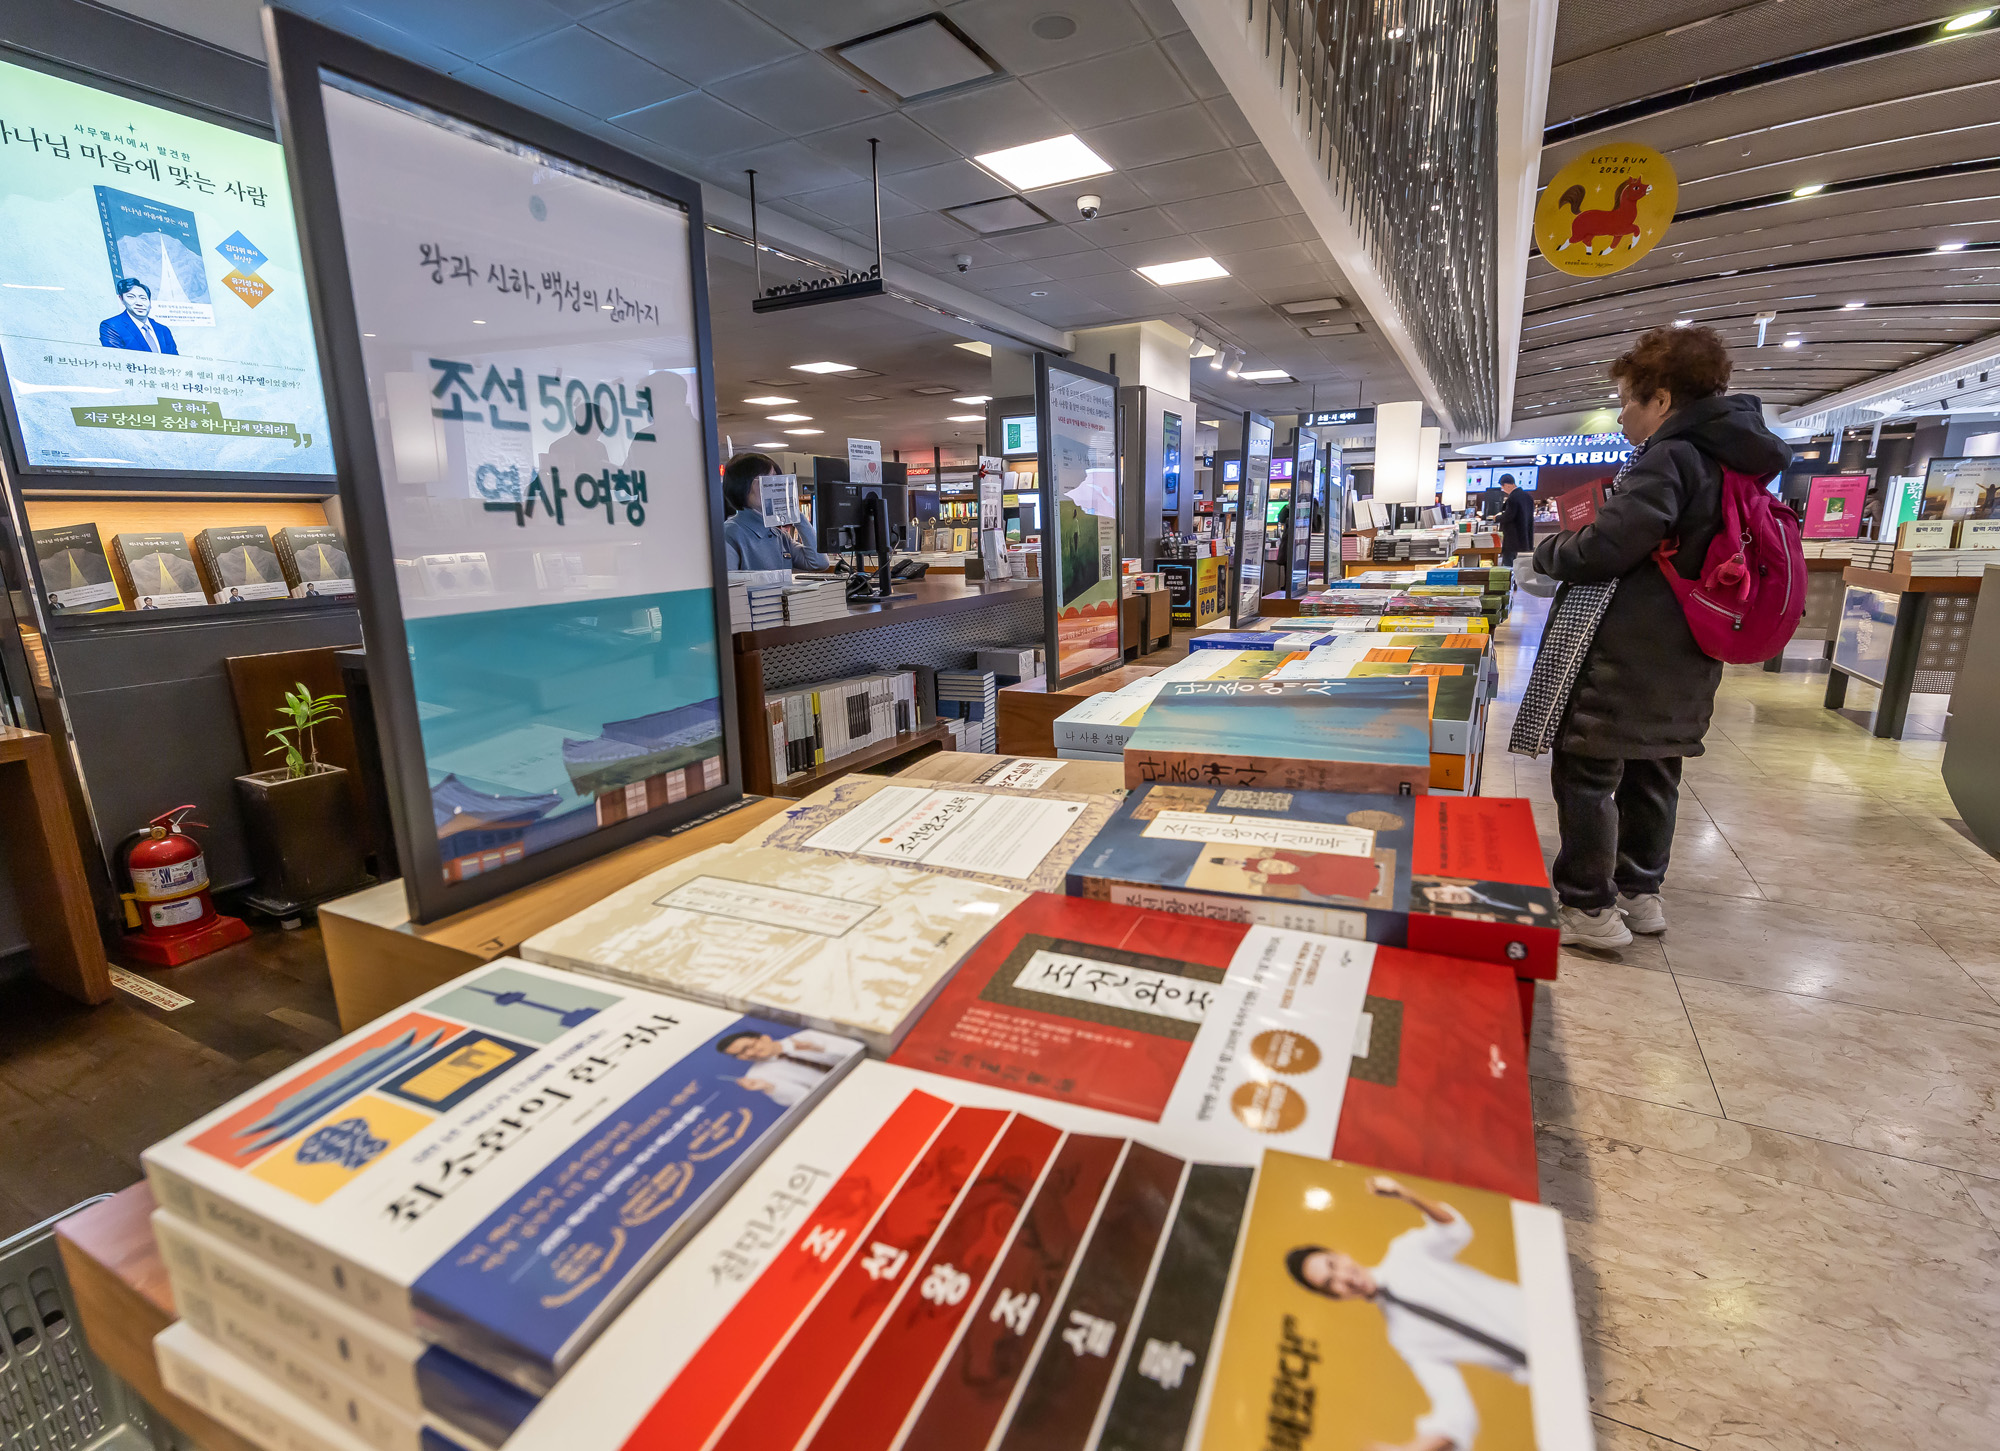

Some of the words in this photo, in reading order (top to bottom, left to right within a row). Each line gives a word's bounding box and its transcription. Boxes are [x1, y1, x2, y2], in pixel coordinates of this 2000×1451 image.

[74, 123, 149, 152] 사무엘서에서
[156, 145, 190, 163] 발견한
[79, 144, 161, 182] 마음에
[167, 163, 216, 195] 맞는
[224, 180, 268, 208] 사람
[1599, 166, 1632, 174] 2026!
[419, 242, 478, 286] 왕과
[606, 287, 660, 326] 삶까지
[43, 355, 53, 364] 왜
[57, 357, 99, 369] 브닌나가
[101, 361, 122, 371] 아닌
[126, 363, 182, 377] 한나였을까?
[185, 370, 194, 378] 왜
[197, 371, 214, 381] 엘리
[217, 373, 234, 382] 대신
[236, 374, 301, 390] 사무엘이었을까?
[125, 378, 134, 387] 왜
[161, 381, 179, 391] 대신
[182, 383, 244, 397] 다윗이었을까?
[429, 358, 530, 432] 조선
[537, 374, 657, 443] 500년
[171, 402, 183, 412] 단
[185, 403, 210, 415] 하나,
[1305, 413, 1313, 426] J
[84, 411, 110, 423] 지금
[112, 412, 156, 428] 당신의
[160, 416, 198, 430] 중심을
[201, 418, 250, 433] 하나님께
[252, 423, 288, 436] 맞춰라!
[906, 468, 931, 476] estseller
[475, 463, 568, 528] 역사
[574, 468, 648, 528] 여행
[1065, 731, 1075, 742] 나
[1079, 731, 1100, 745] 사용
[895, 796, 976, 854] 조선왕조실록
[1163, 823, 1349, 850] 조선왕조실록
[158, 868, 173, 884] SW
[1126, 896, 1252, 924] 조선왕조실록
[384, 1086, 572, 1231] 최소한의
[572, 1012, 682, 1085] 한국사
[708, 1163, 832, 1286] 설민석의
